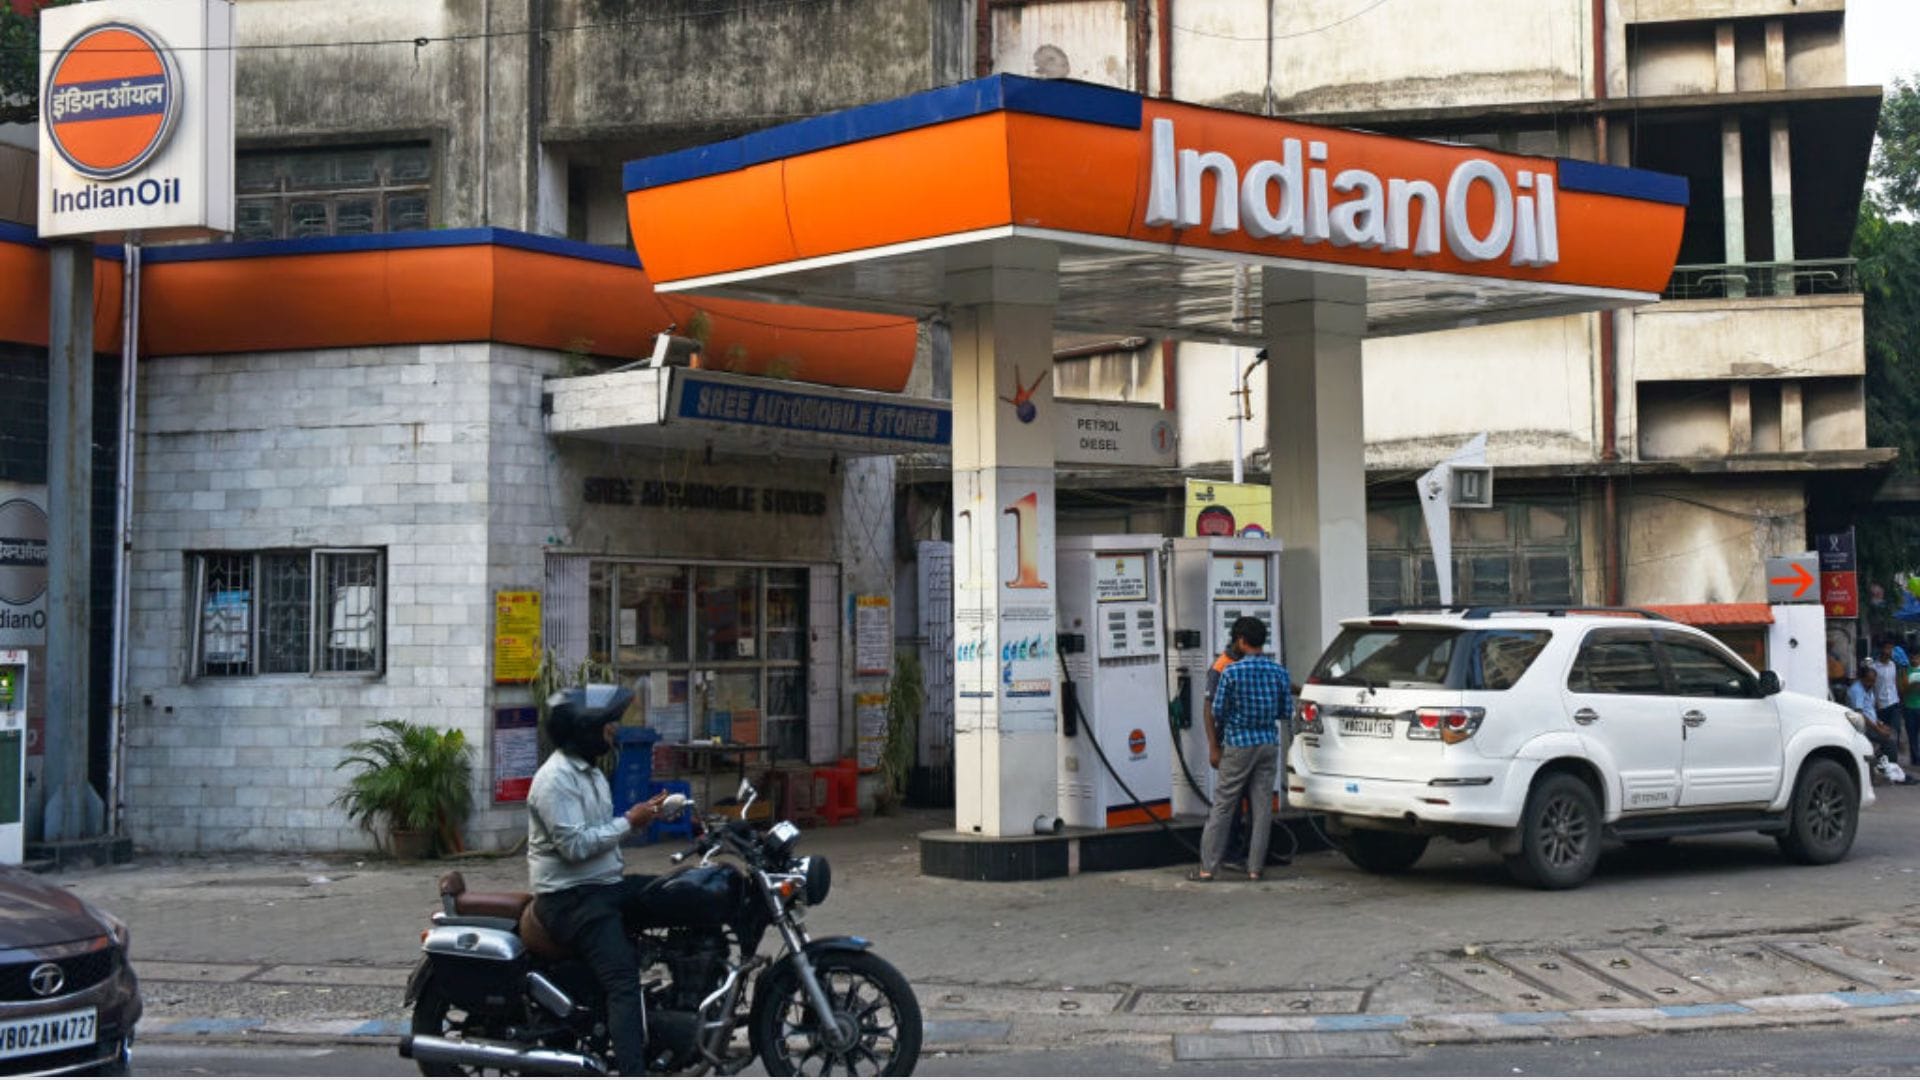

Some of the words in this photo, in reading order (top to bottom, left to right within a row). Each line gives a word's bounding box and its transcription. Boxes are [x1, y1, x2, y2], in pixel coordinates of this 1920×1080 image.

[53, 81, 164, 119] इंडियनऑयल
[52, 178, 180, 213] IndianOil
[1144, 117, 1559, 268] IndianOil
[697, 386, 752, 420] SREE
[752, 393, 870, 433] AUTOMOBILE
[873, 406, 938, 439] STORES
[1077, 418, 1122, 432] PETROL
[1080, 437, 1119, 451] DIESEL
[1157, 427, 1167, 449] 1
[1003, 491, 1048, 589] 1
[0, 608, 46, 629] dianO
